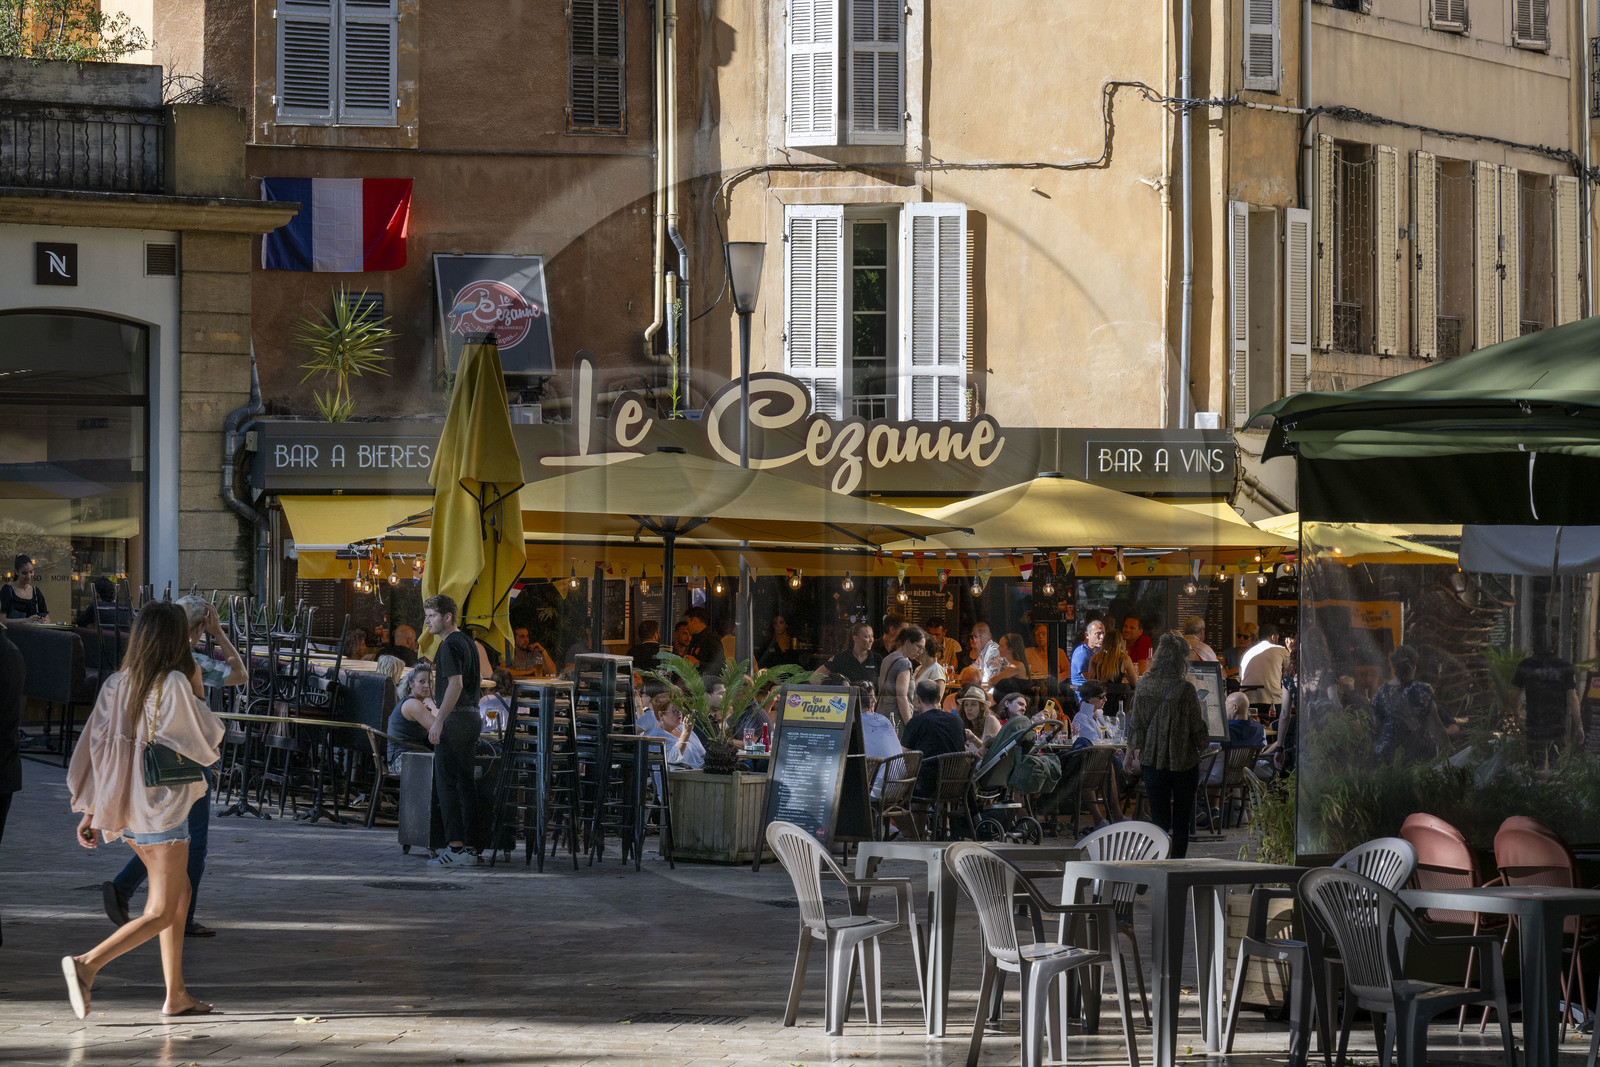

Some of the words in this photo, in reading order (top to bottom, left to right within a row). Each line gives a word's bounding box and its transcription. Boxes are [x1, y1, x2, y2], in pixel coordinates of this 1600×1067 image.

[498, 294, 514, 307] Le
[540, 358, 653, 467] Le
[707, 378, 1006, 495] Cezanne
[274, 444, 319, 468] BAR
[330, 444, 345, 468] A
[357, 444, 431, 468] BIERES
[1098, 448, 1143, 472] BAR
[1154, 448, 1169, 472] A
[1179, 448, 1225, 473] VINS
[801, 701, 831, 716] Tapas
[811, 695, 823, 704] Las
